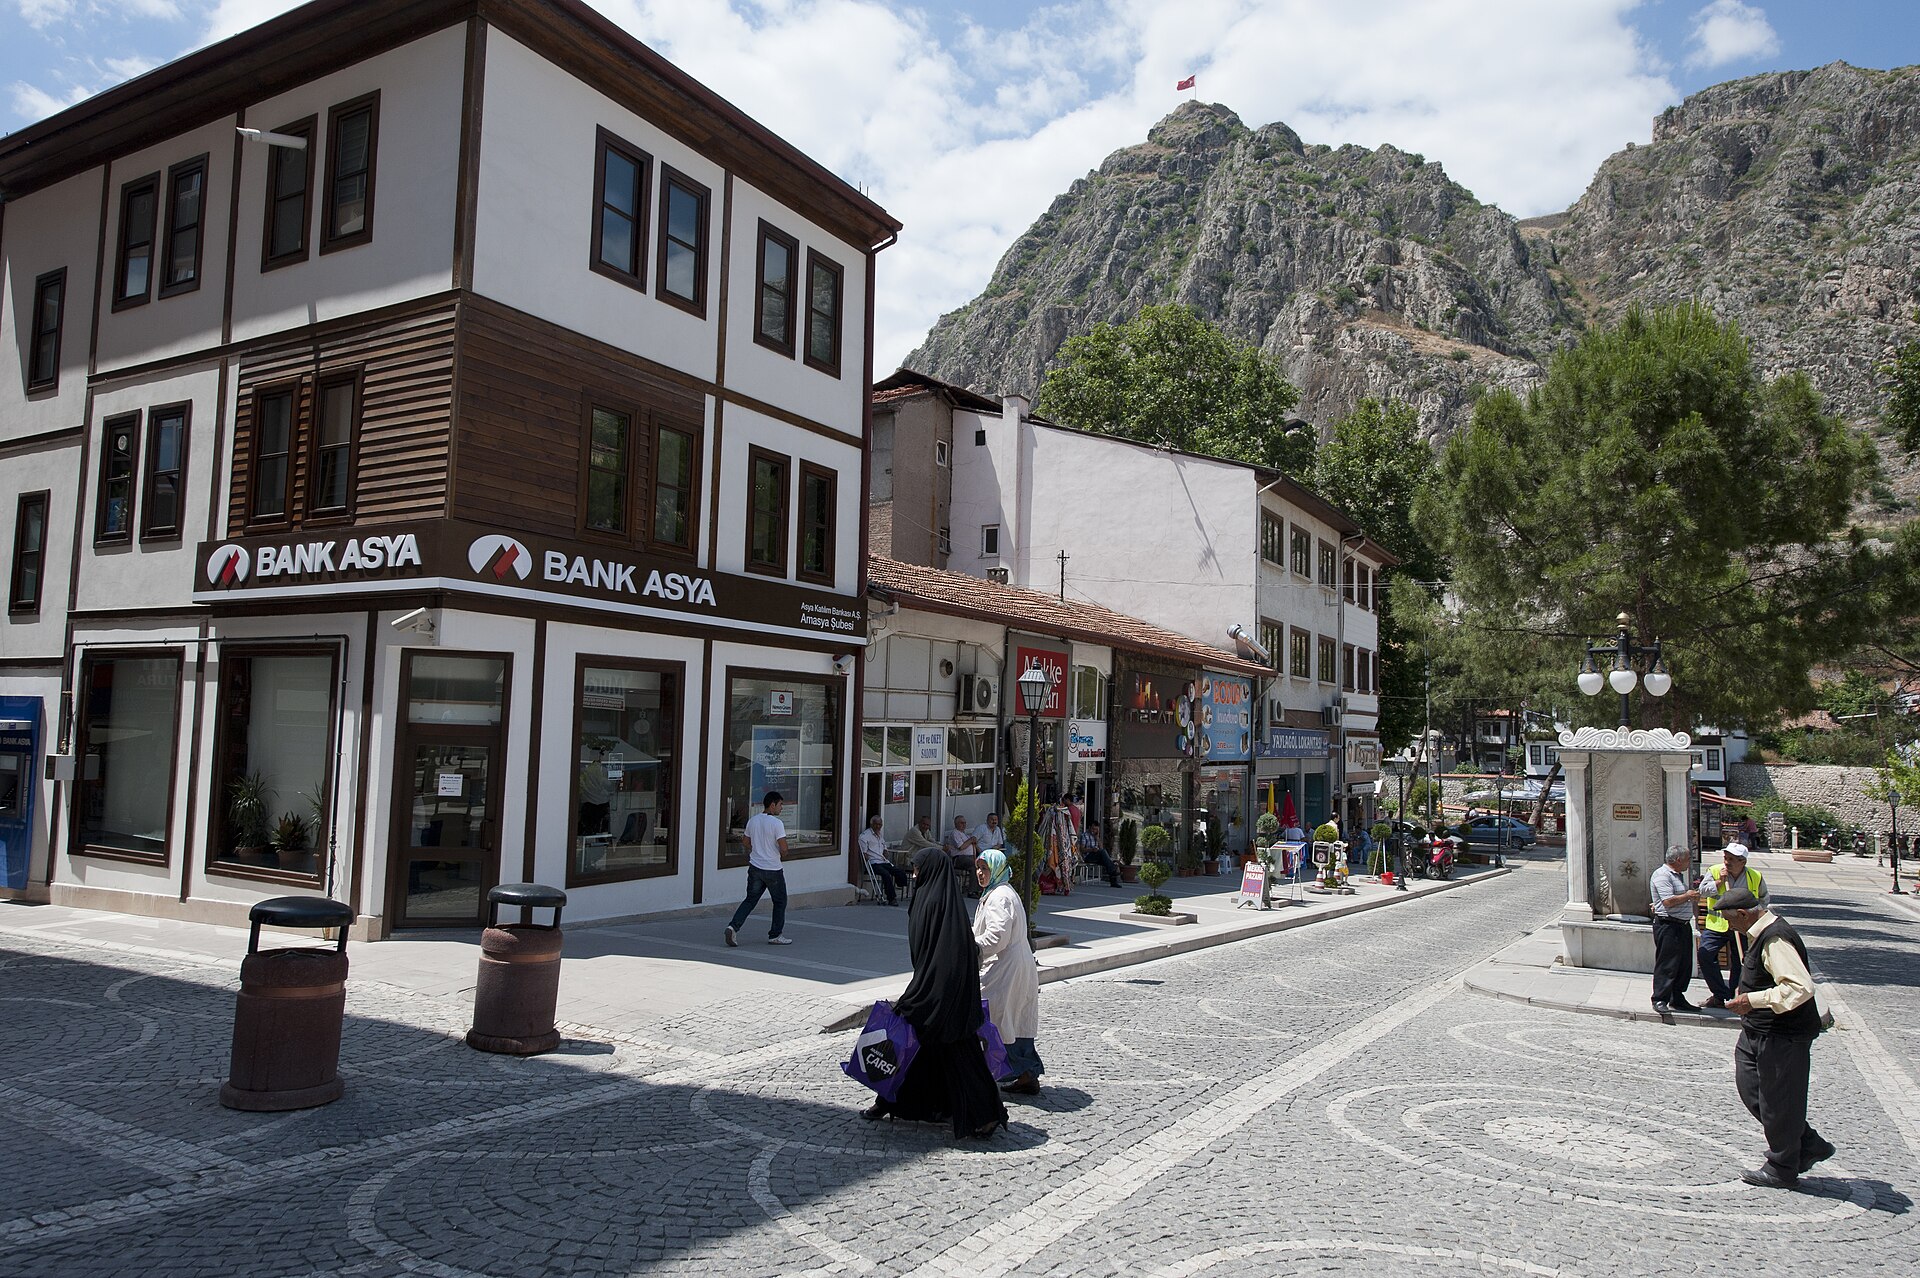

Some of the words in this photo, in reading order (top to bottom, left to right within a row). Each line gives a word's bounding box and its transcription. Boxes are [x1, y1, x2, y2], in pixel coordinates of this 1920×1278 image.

[256, 541, 336, 577] BANK
[339, 533, 422, 571] ASYA
[543, 550, 637, 594] BANK
[642, 570, 717, 607] ASYA
[801, 602, 814, 612] Asya
[801, 613, 829, 628] Amasya
[831, 617, 854, 630] Şubesi
[1024, 655, 1062, 684] Mkke
[3, 737, 21, 745] BANK
[20, 738, 31, 746] ASYA
[917, 734, 925, 747] ÇAY
[931, 734, 942, 745] OKEY
[921, 748, 938, 758] SALONU
[866, 1053, 897, 1075] ÇARŞI
